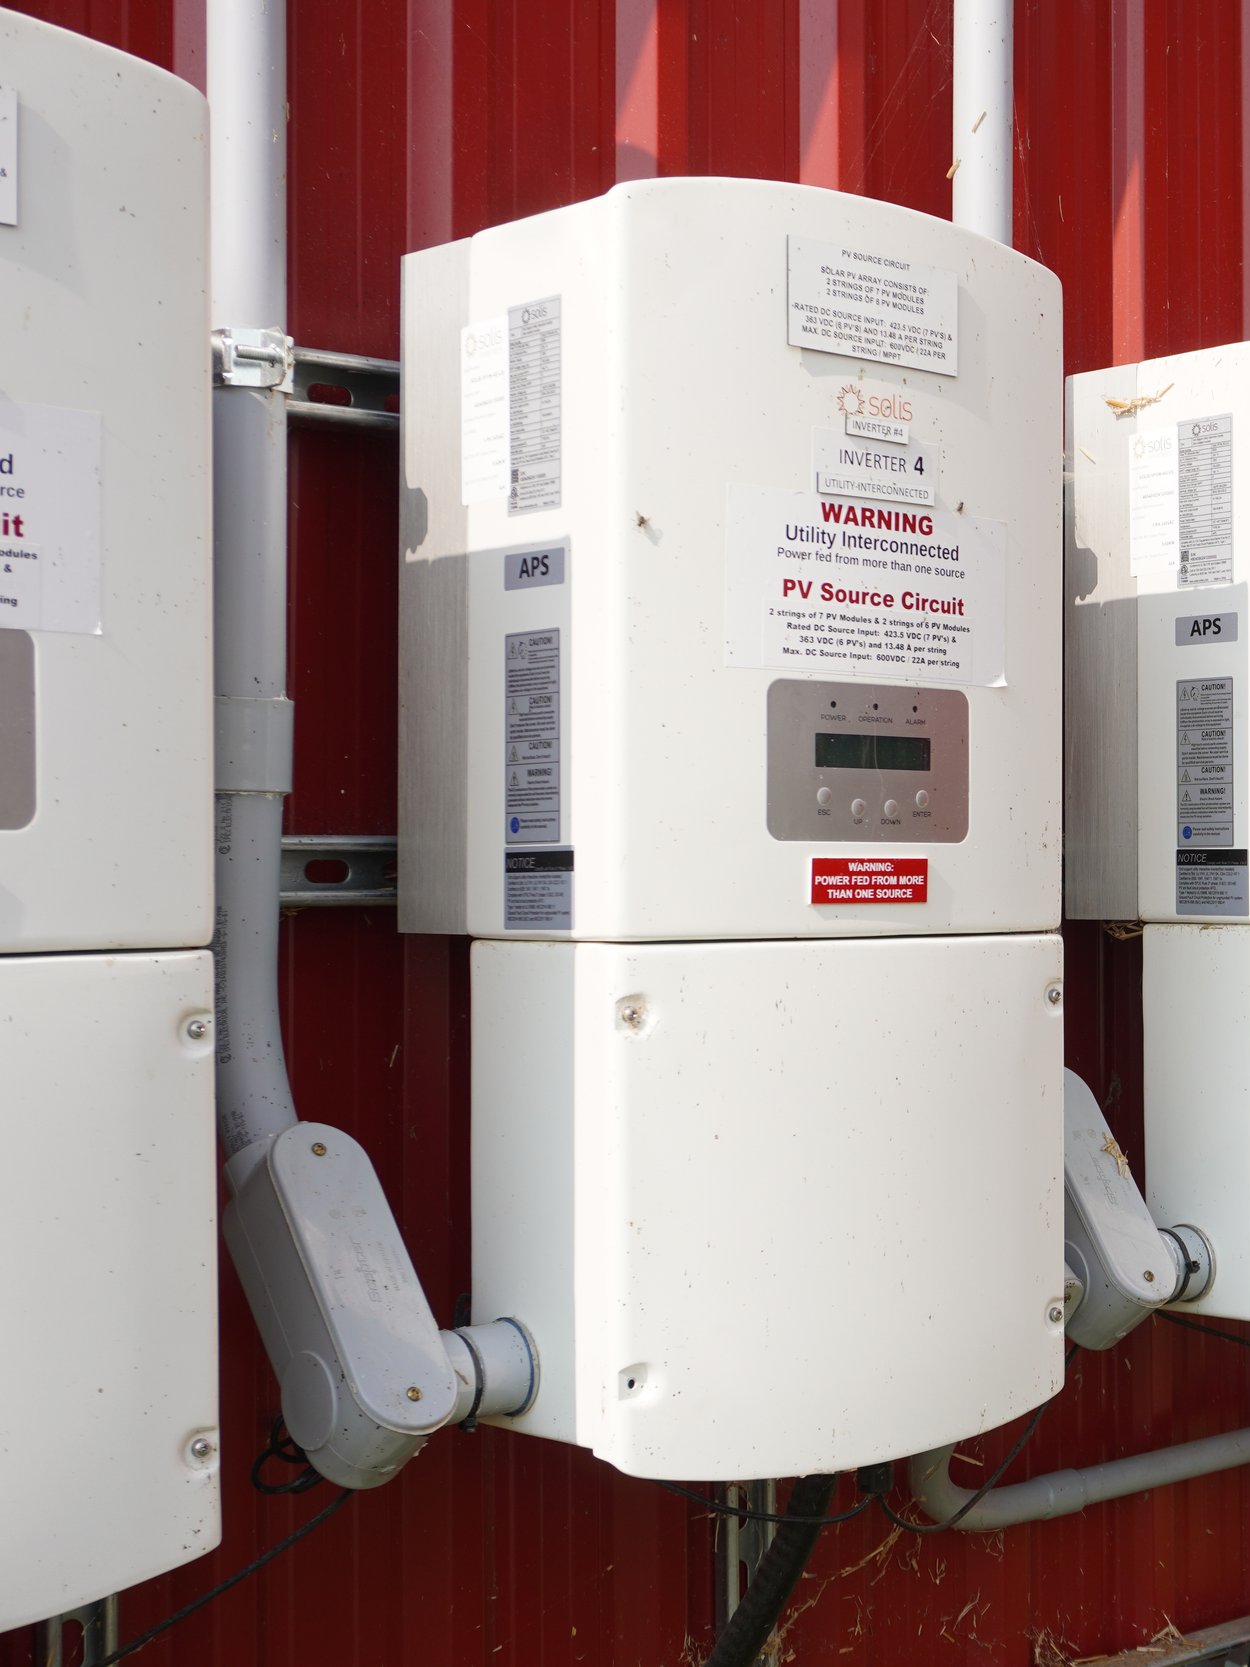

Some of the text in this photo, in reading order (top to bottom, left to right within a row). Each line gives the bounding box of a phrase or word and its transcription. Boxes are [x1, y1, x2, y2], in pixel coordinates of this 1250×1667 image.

[842, 250, 910, 271] PV SOURCE CIRCUIT
[821, 266, 845, 277] SOLAR
[846, 272, 856, 280] PV
[858, 274, 882, 285] ARRAY
[883, 280, 917, 292] CONSISTS
[869, 394, 913, 421] solis
[852, 420, 903, 437] INVERTER #4
[839, 449, 924, 475] INVERTER 4
[825, 478, 929, 500] UTILITY-INTERCONNECTED
[821, 502, 933, 536] WARNING
[785, 524, 959, 561] Utility Interconnected
[519, 555, 549, 579] APS
[777, 547, 965, 579] Power fed from more than one source
[783, 579, 964, 616] PV Source Circuit
[769, 608, 774, 616] 2
[777, 609, 805, 619] strings
[809, 611, 816, 619] of
[819, 612, 824, 620] 7
[826, 613, 837, 621] PV
[839, 614, 871, 624] Modules
[874, 616, 879, 624] &
[882, 617, 887, 625] 2
[889, 619, 914, 629] strings
[916, 621, 924, 629] of
[930, 622, 941, 630] PV
[943, 623, 970, 633] Modules
[787, 622, 811, 631] Rated
[814, 624, 825, 632] DC
[828, 625, 855, 635] Source
[857, 628, 880, 637] Input:
[884, 631, 904, 639] 423.5
[906, 632, 921, 640] VDC
[1190, 618, 1221, 637] APS
[506, 858, 535, 870] NOTICE
[848, 863, 894, 872] WARNING:
[1178, 853, 1207, 863] NOTICE
[815, 876, 924, 885] POWER FED FROM MORE
[827, 889, 912, 898] THAN ONE SOURCE
